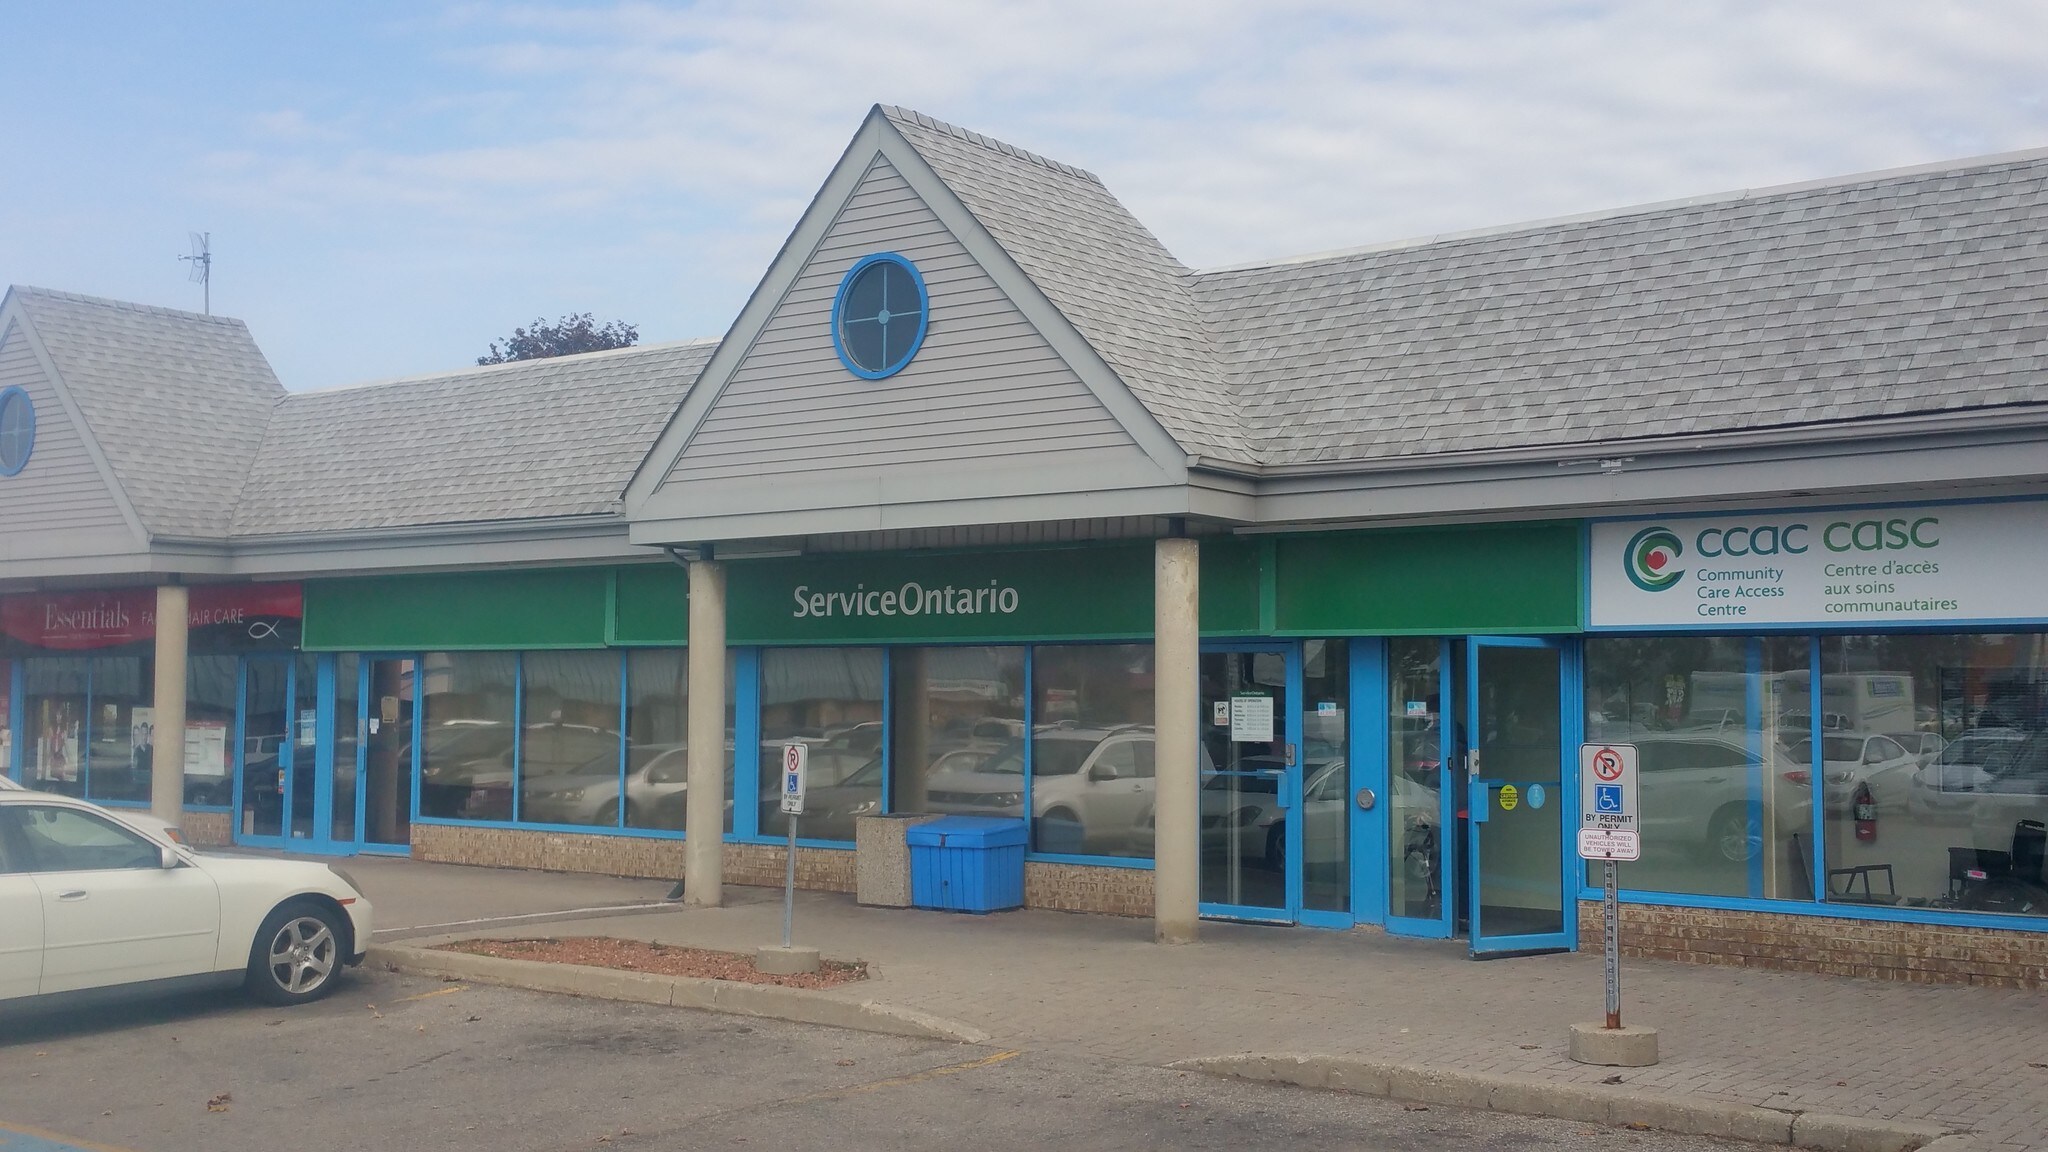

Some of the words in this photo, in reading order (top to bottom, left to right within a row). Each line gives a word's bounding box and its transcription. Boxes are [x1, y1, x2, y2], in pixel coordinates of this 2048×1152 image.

[1695, 523, 1809, 558] ccac
[1822, 517, 1940, 553] casc
[1696, 566, 1784, 583] Community
[1823, 562, 1877, 577] Centre
[1881, 560, 1940, 575] d'accès
[1696, 586, 1730, 599] Care
[1734, 584, 1784, 598] Access
[1824, 583, 1851, 595] aux
[1855, 580, 1895, 594] soins
[793, 579, 1019, 618] ServiceOntario
[1824, 597, 1958, 613] communautaires
[44, 601, 130, 630] Essentials
[213, 608, 244, 624] CARE
[1696, 603, 1747, 616] Centre
[1585, 813, 1596, 821] BY
[1599, 815, 1633, 823] PERMIT
[1584, 834, 1632, 842] UNAUTHORIZED
